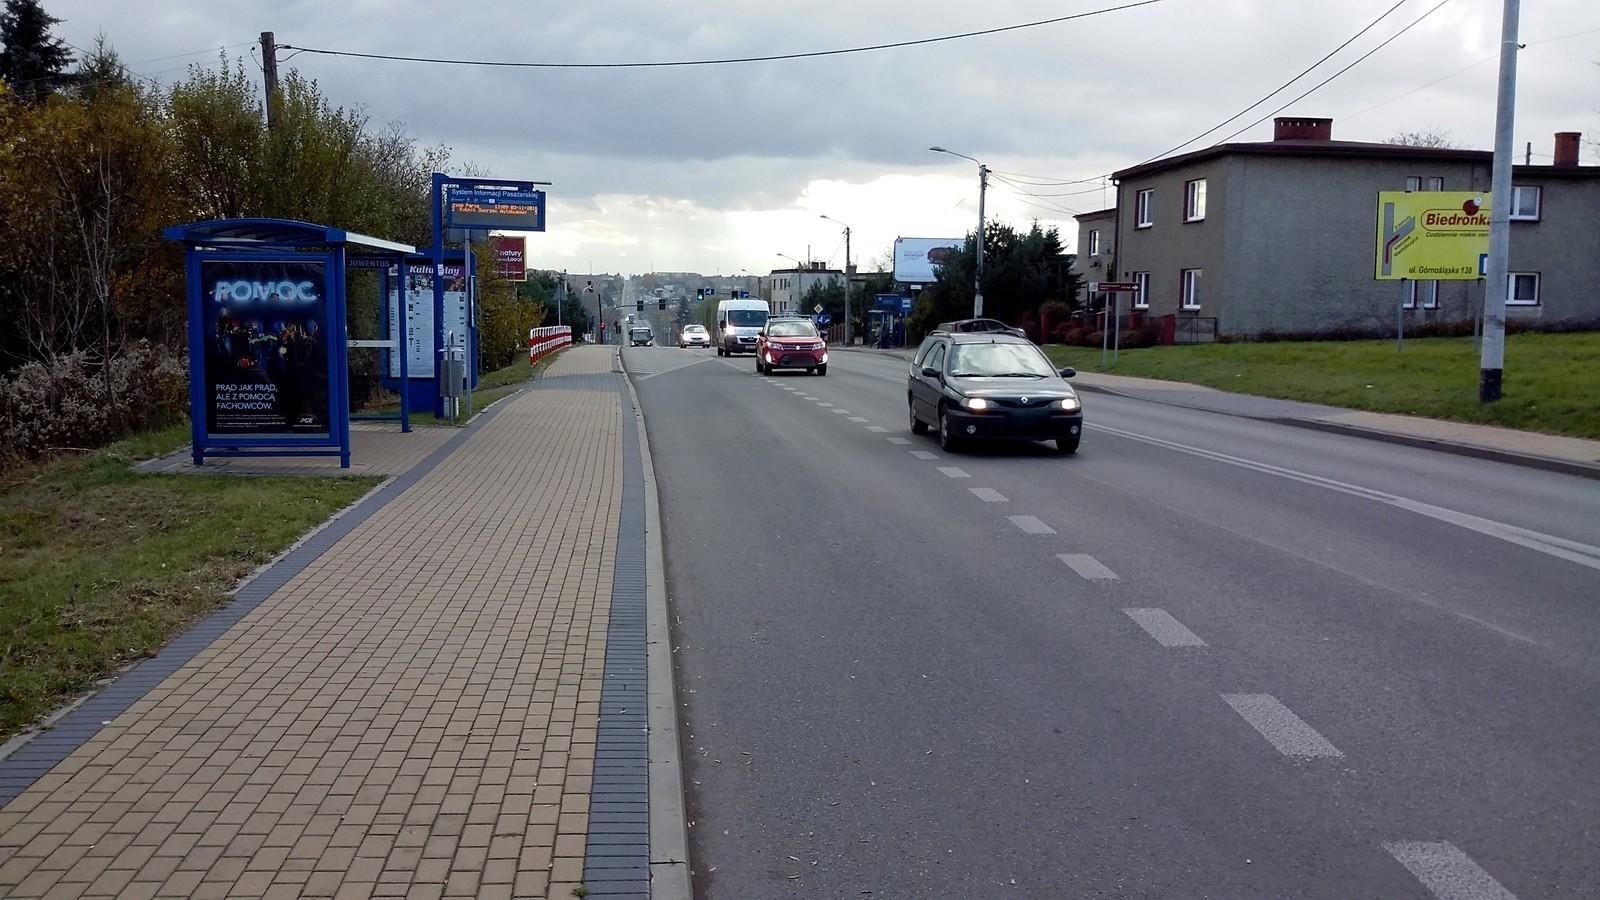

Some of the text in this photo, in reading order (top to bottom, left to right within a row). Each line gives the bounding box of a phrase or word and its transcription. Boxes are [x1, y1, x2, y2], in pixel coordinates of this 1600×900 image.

[502, 190, 538, 199] Pasażerskiej
[1418, 266, 1459, 275] Górnośląska
[216, 384, 237, 392] PRĄD
[240, 394, 276, 402] POMOCĄ
